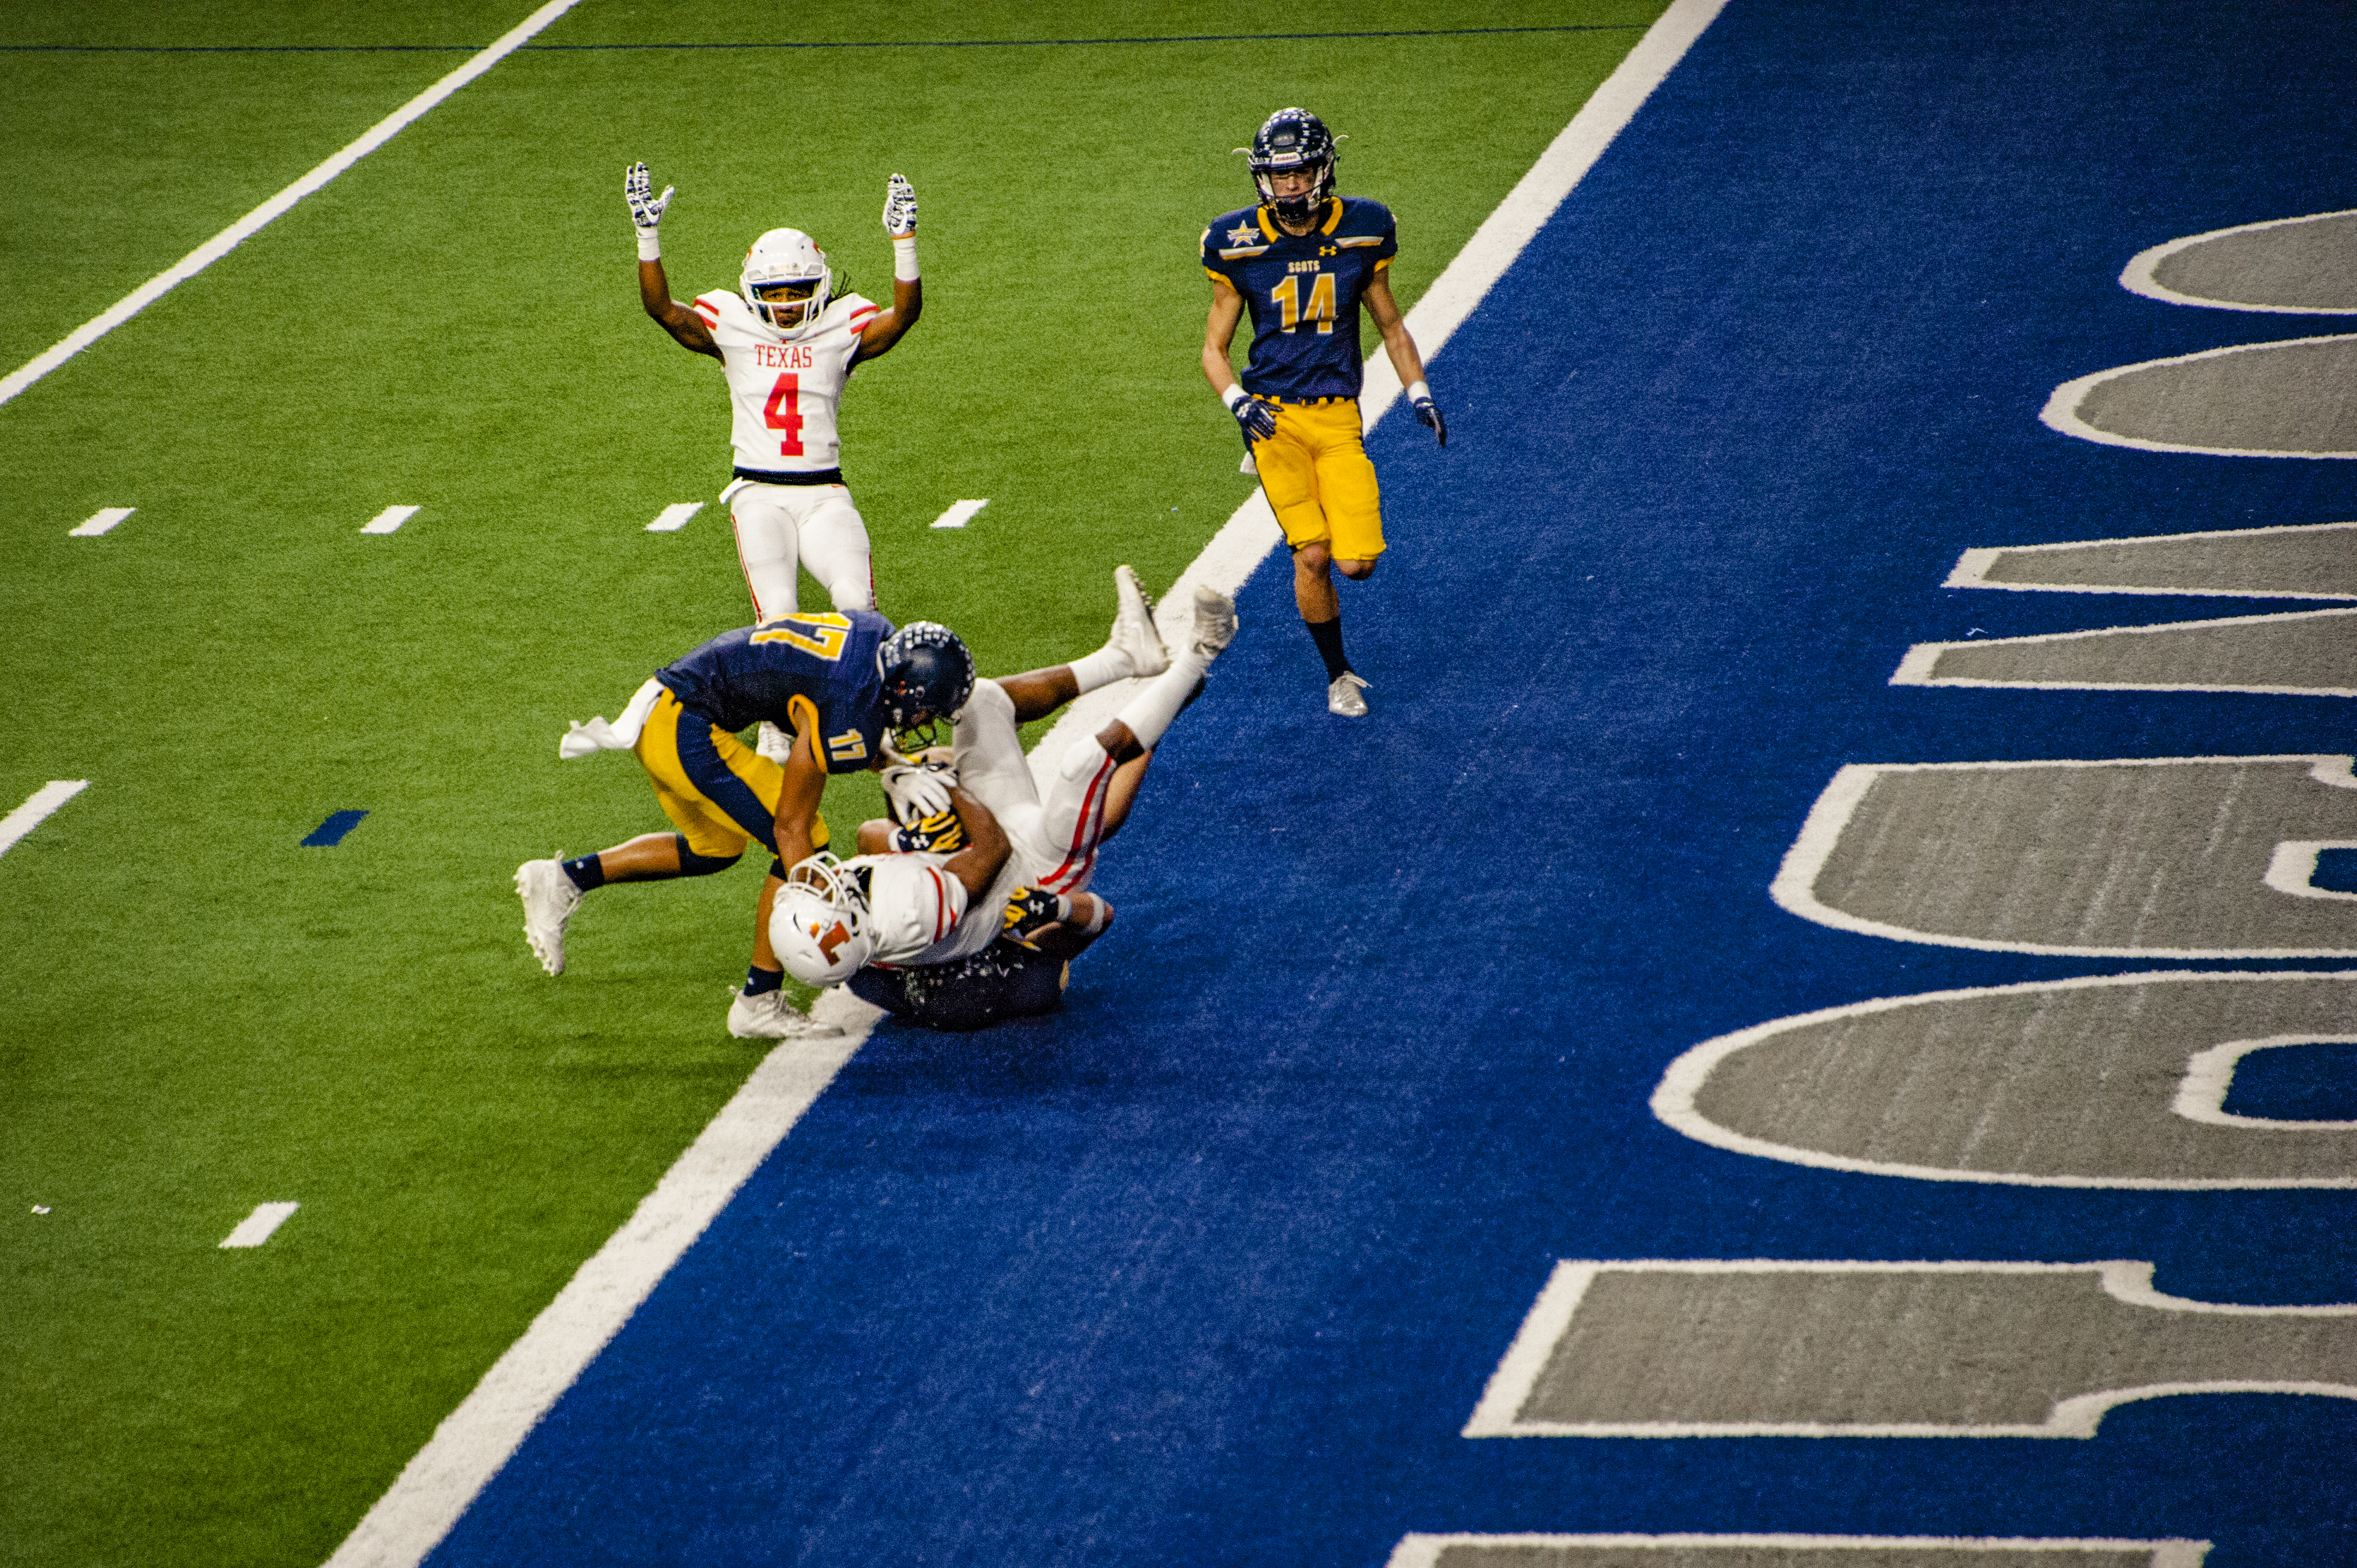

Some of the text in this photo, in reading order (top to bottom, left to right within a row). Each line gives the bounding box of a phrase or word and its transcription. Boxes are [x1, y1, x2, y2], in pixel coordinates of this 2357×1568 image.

[1288, 260, 1320, 273] SCOTS
[1271, 272, 1337, 334] 14
[755, 344, 812, 368] TEXAS
[763, 373, 803, 456] 4
[749, 612, 852, 661] 17
[828, 728, 867, 761] 17
